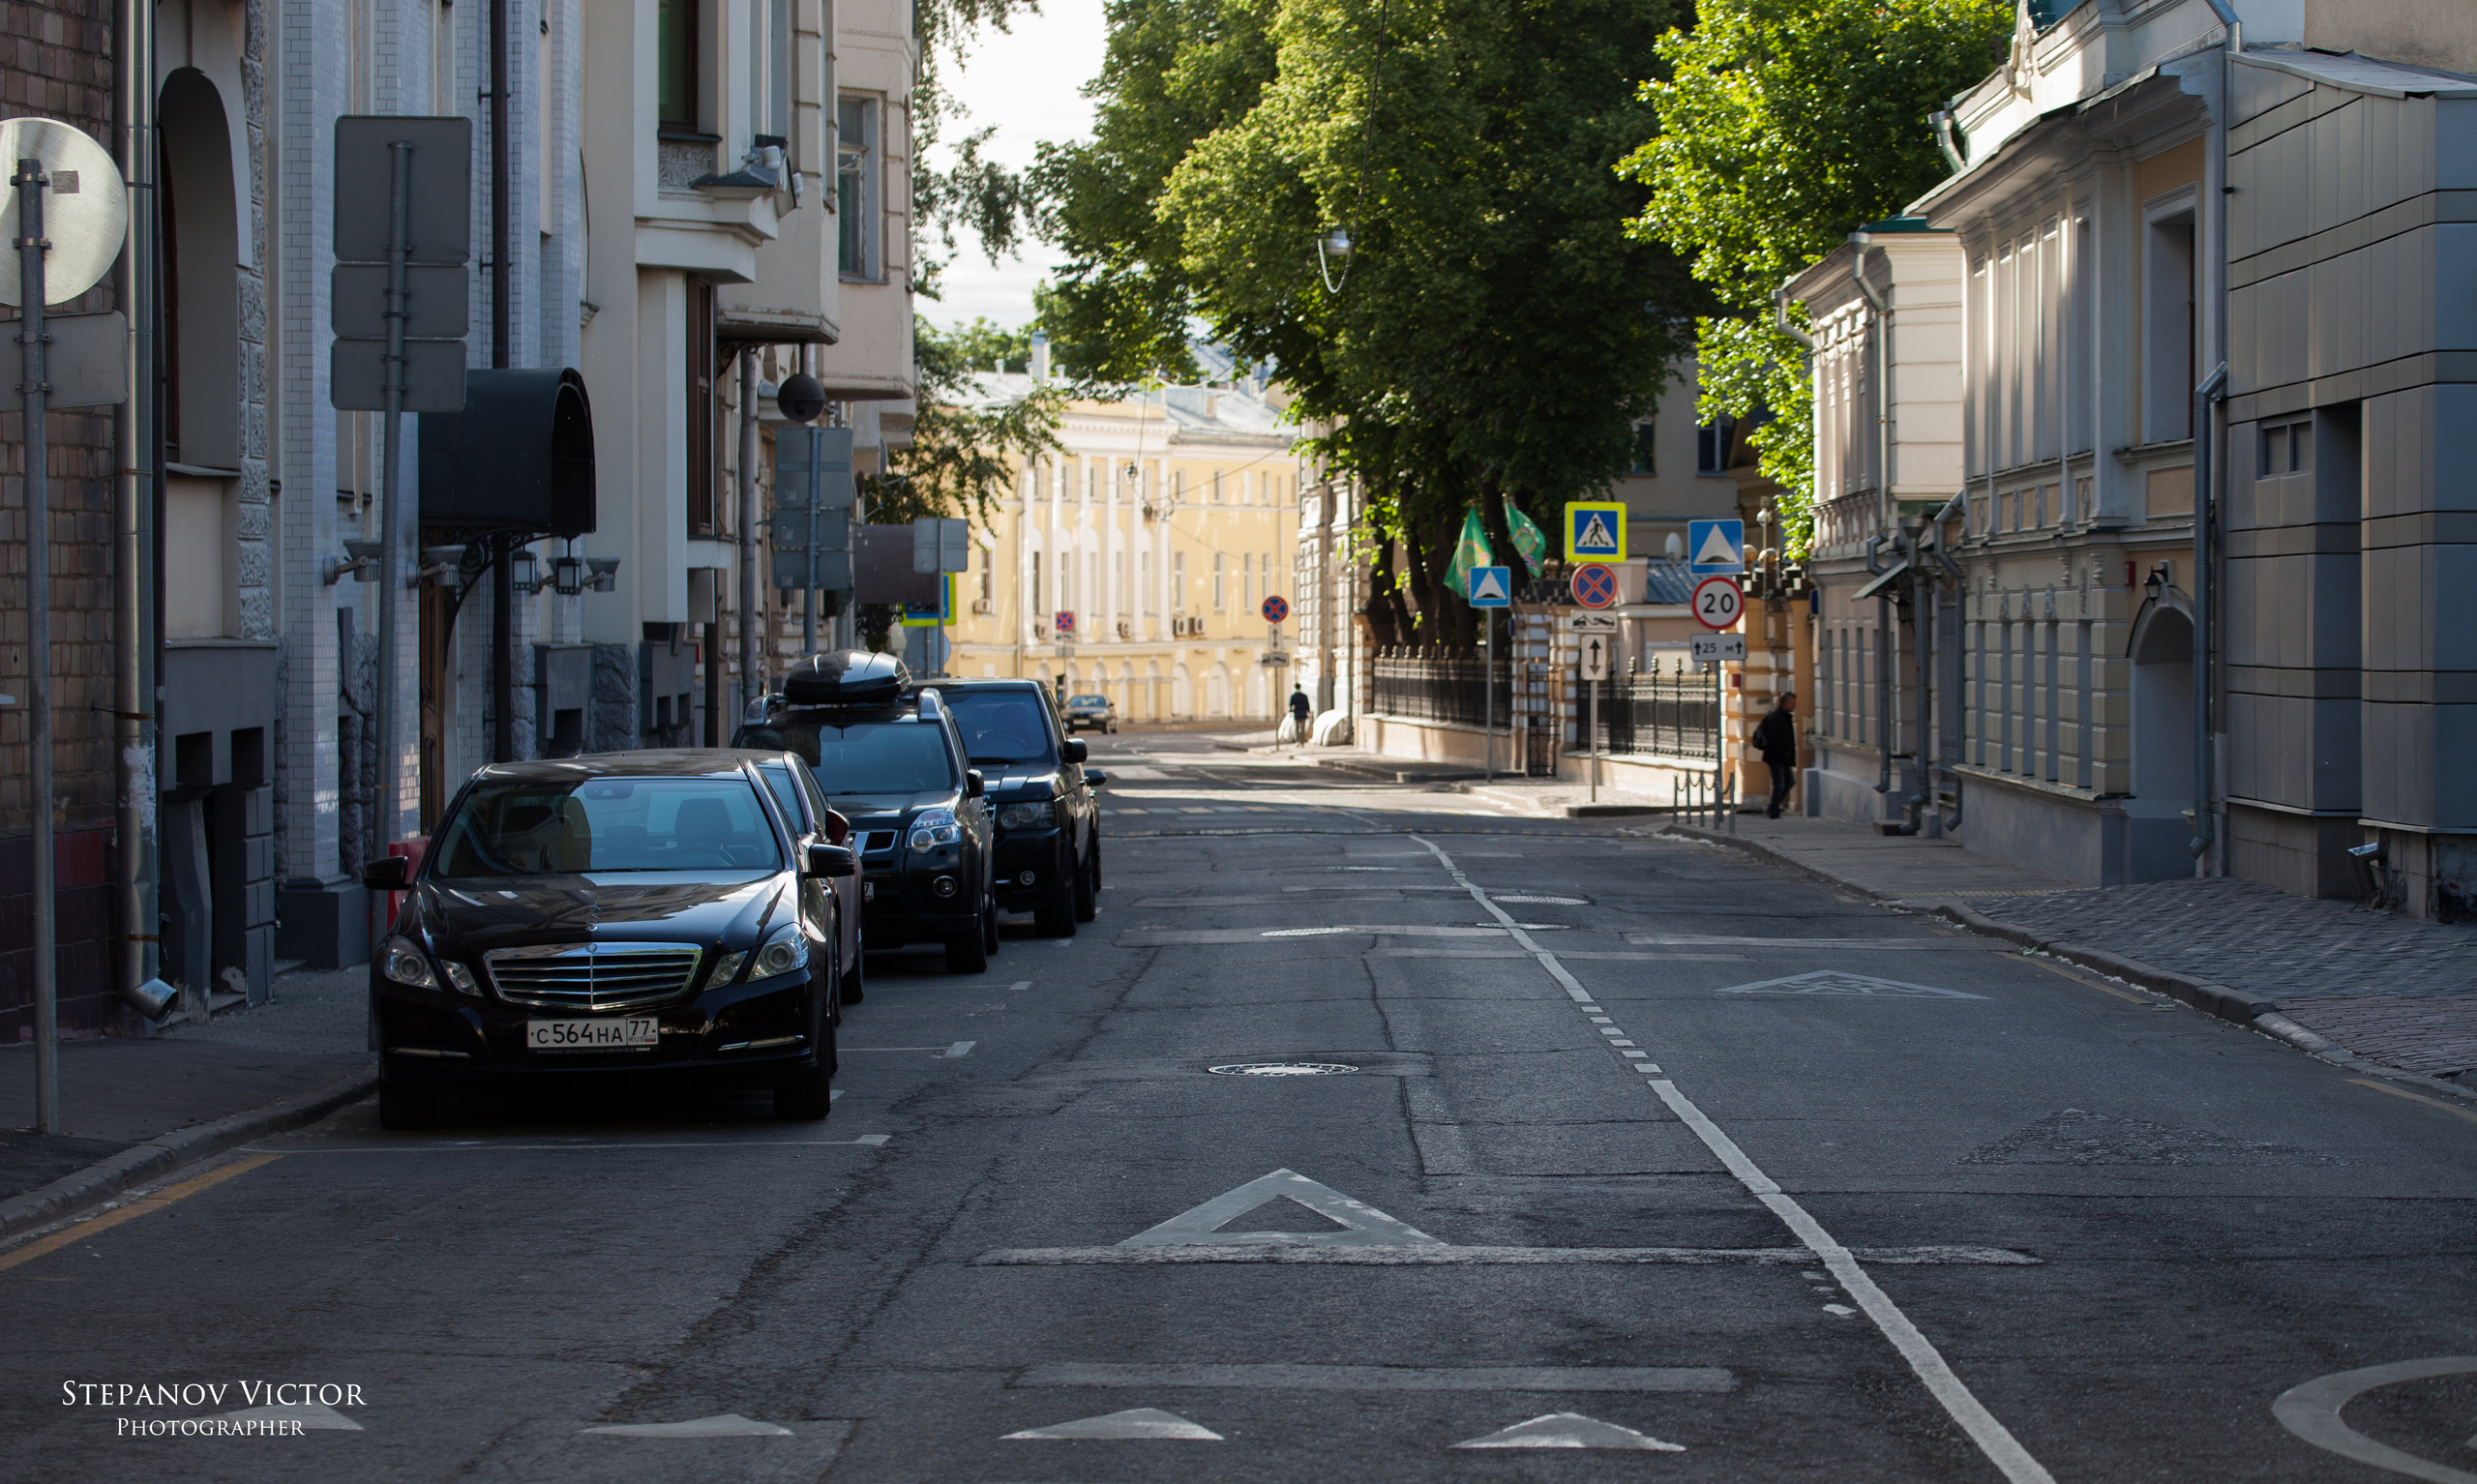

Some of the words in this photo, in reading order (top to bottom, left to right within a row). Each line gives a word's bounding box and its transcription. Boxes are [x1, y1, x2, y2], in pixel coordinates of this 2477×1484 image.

[1703, 592, 1734, 613] 20
[1703, 642, 1717, 653] 25
[629, 1020, 650, 1035] 77
